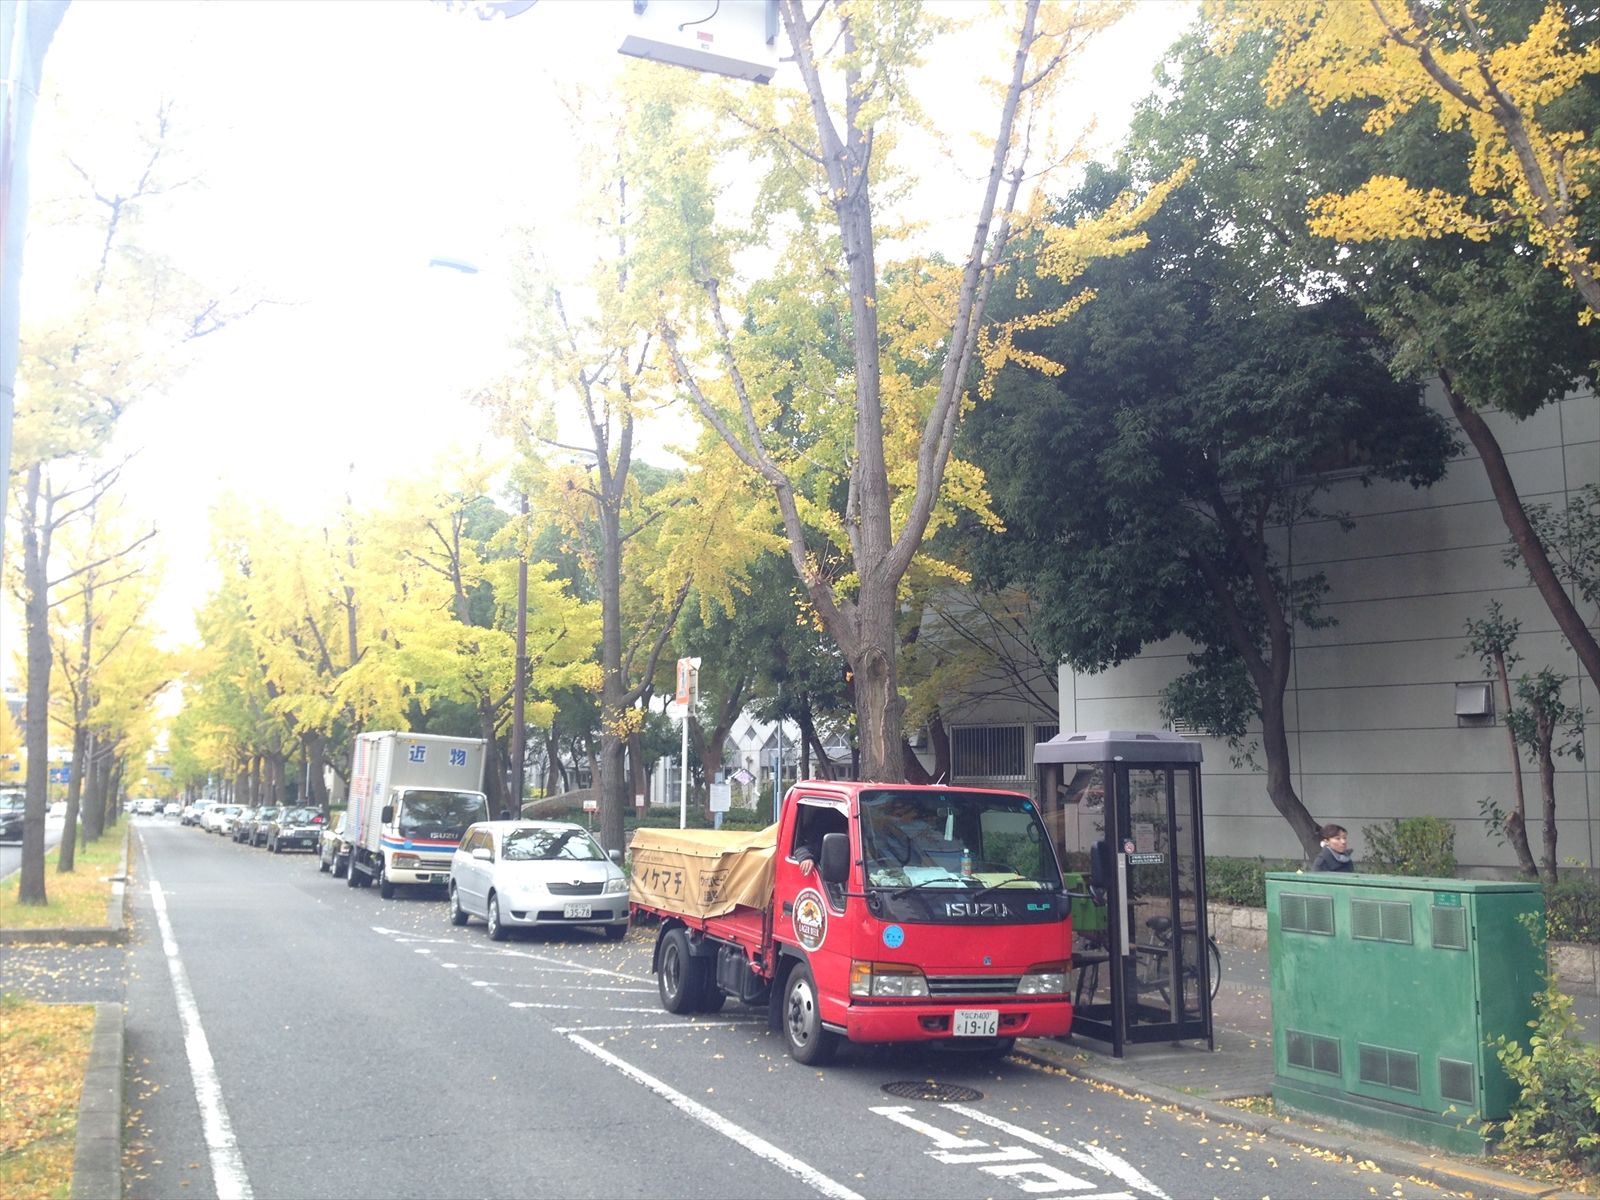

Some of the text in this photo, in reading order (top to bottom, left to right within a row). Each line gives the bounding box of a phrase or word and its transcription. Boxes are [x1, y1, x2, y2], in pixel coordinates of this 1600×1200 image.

[409, 744, 467, 766] 近物
[430, 832, 458, 840] ISUZU
[641, 867, 682, 896] イケマチ
[944, 903, 1008, 917] ISUZU
[964, 1020, 996, 1035] 19-16
